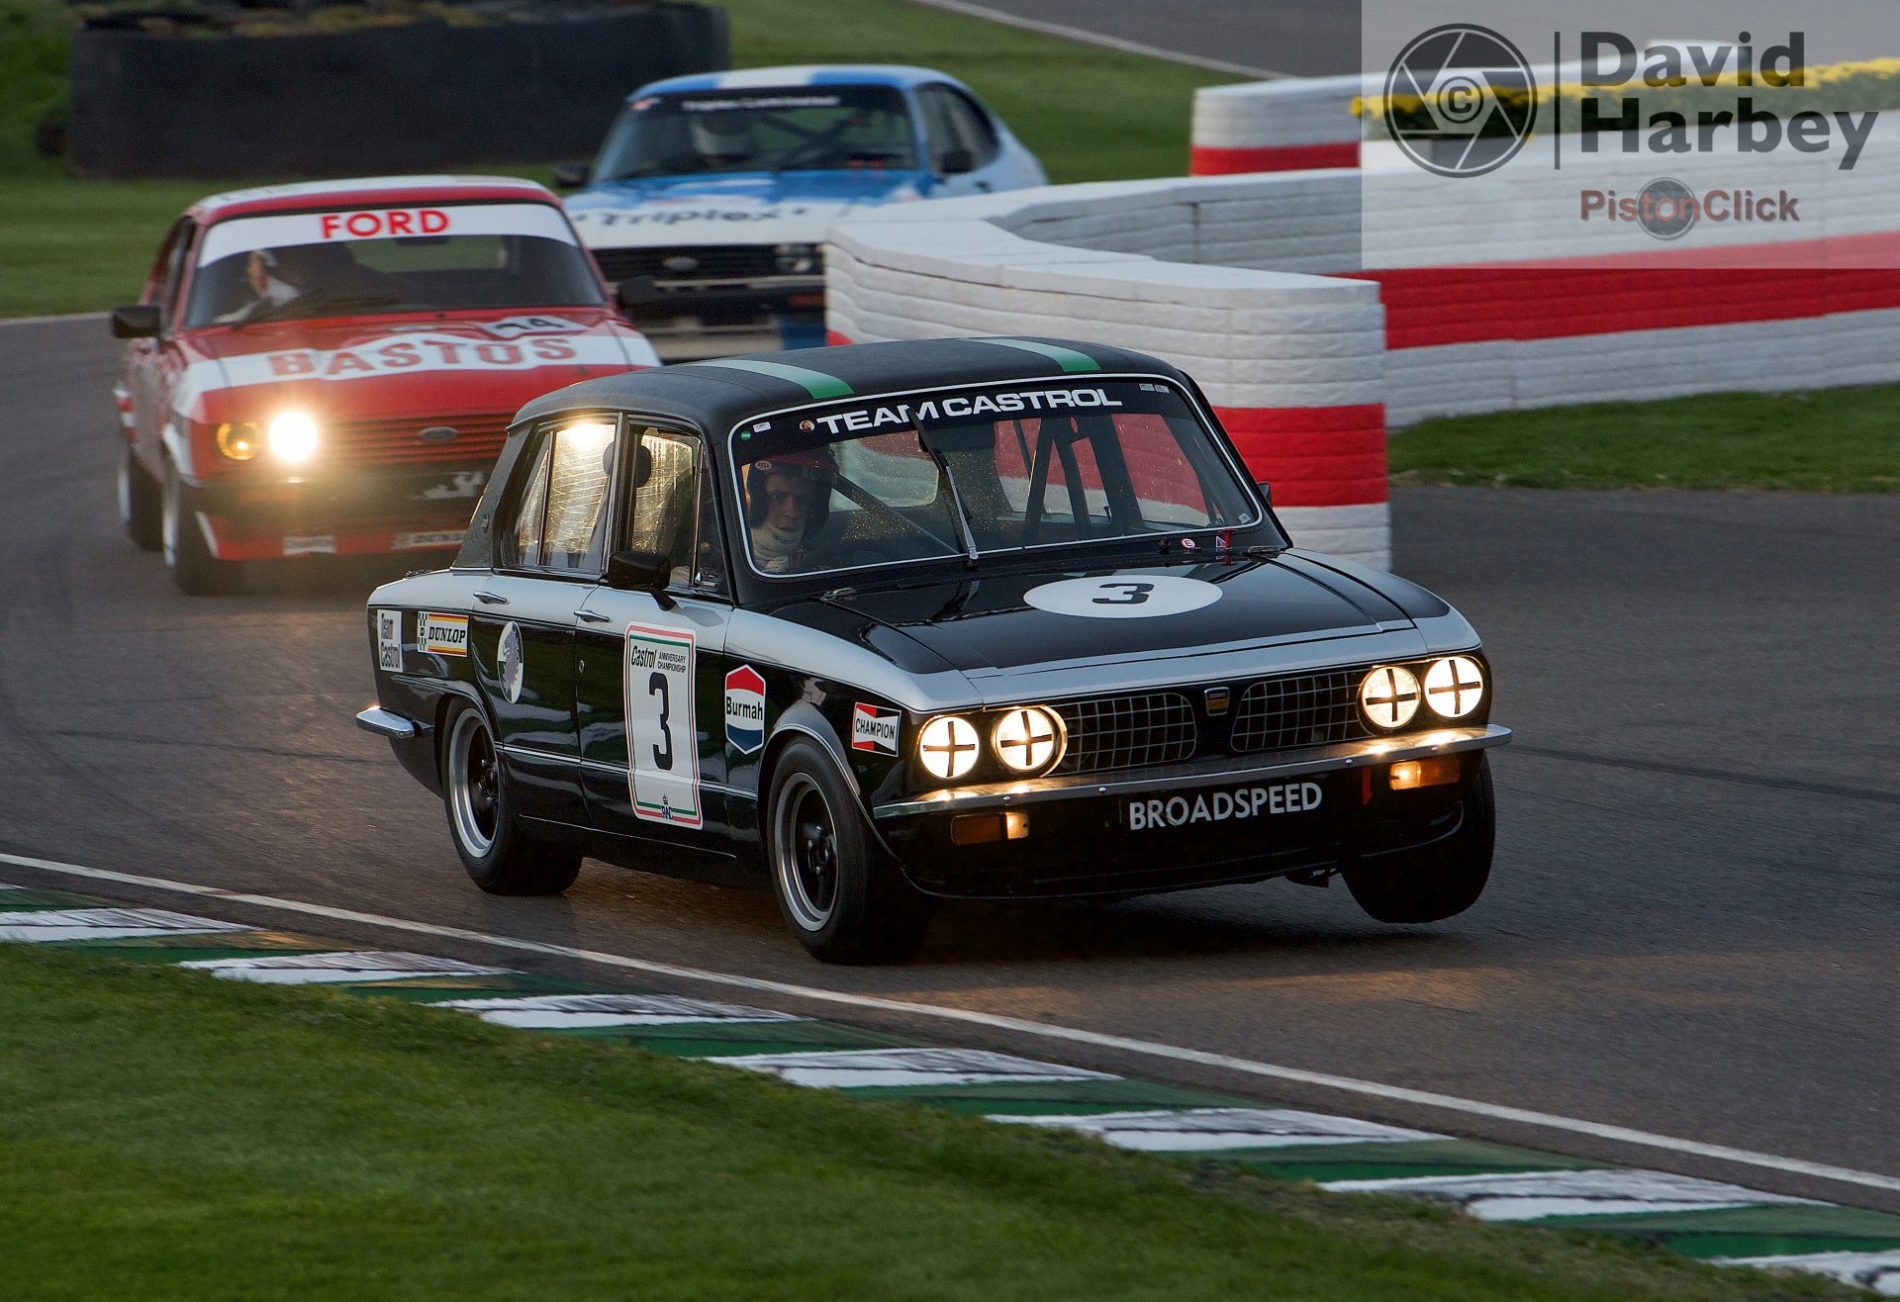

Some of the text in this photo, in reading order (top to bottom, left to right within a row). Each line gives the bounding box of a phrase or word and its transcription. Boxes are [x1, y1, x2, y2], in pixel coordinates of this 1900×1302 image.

[320, 207, 451, 240] FORD
[268, 337, 580, 377] BASTOS
[816, 388, 1123, 435] TEAM CASTROL
[1092, 582, 1155, 605] 3
[428, 627, 466, 643] DUNLOP
[631, 645, 657, 669] Castrol
[648, 671, 673, 771] 3
[726, 695, 763, 721] Burmah
[855, 716, 896, 740] CHAMPION
[1129, 781, 1323, 830] BROADSPEED
